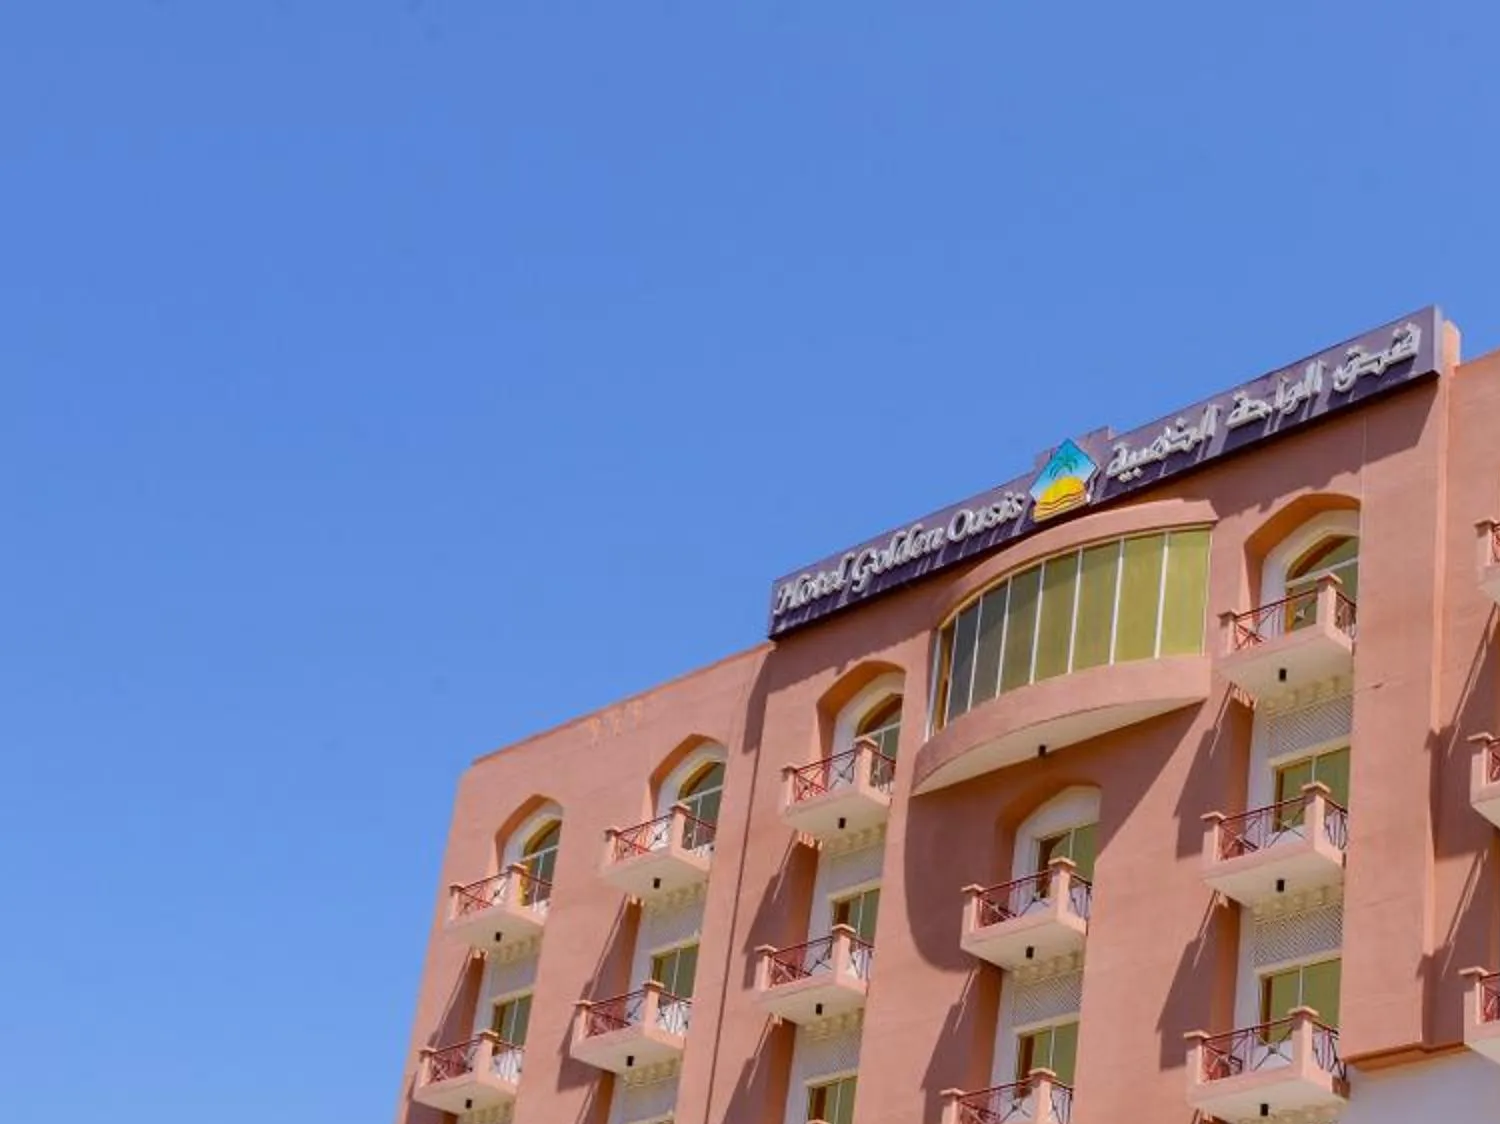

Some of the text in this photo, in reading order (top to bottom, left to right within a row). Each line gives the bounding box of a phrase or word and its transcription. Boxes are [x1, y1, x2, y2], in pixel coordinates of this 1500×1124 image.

[1106, 323, 1422, 482] فندق الواحة الذهبية
[774, 491, 1026, 614] Hotel Golden Oasis
